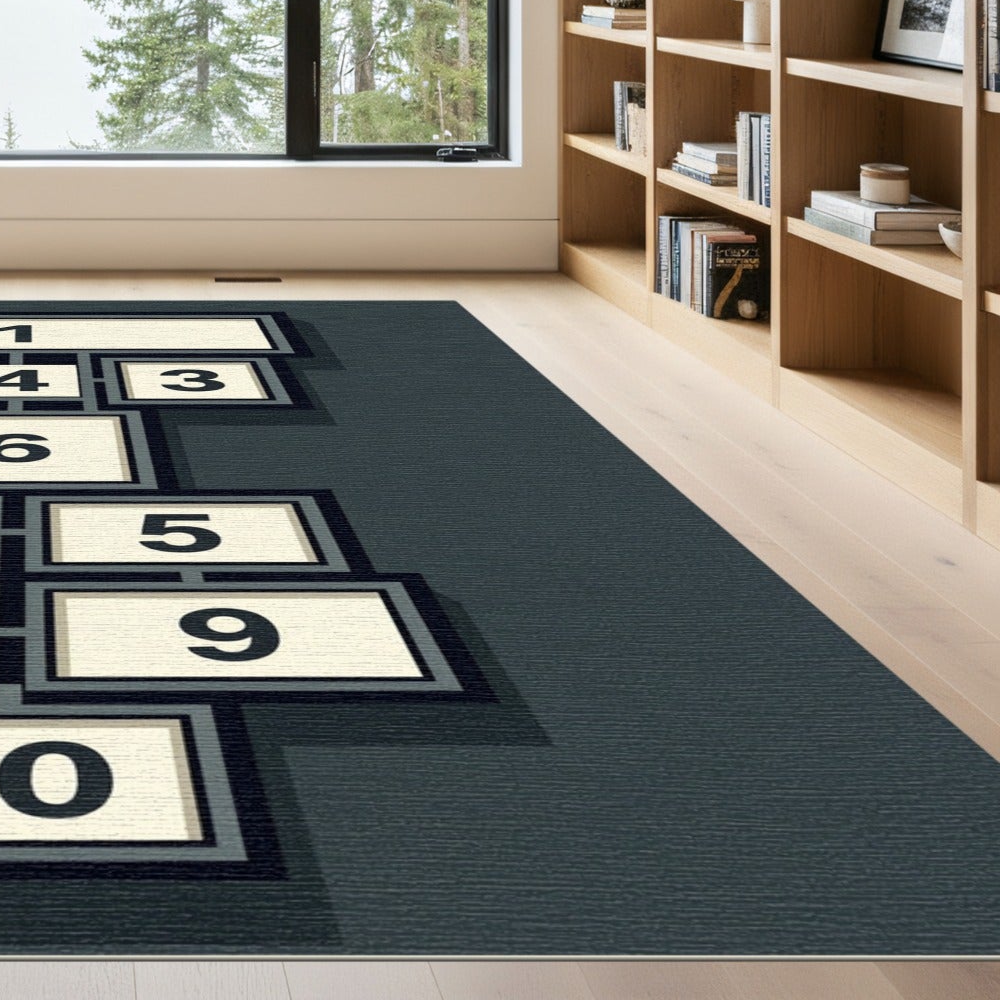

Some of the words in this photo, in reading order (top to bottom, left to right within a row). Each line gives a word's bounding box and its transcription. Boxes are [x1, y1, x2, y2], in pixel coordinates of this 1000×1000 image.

[160, 369, 226, 392] 3
[140, 514, 222, 552] 5
[179, 608, 280, 661] 9
